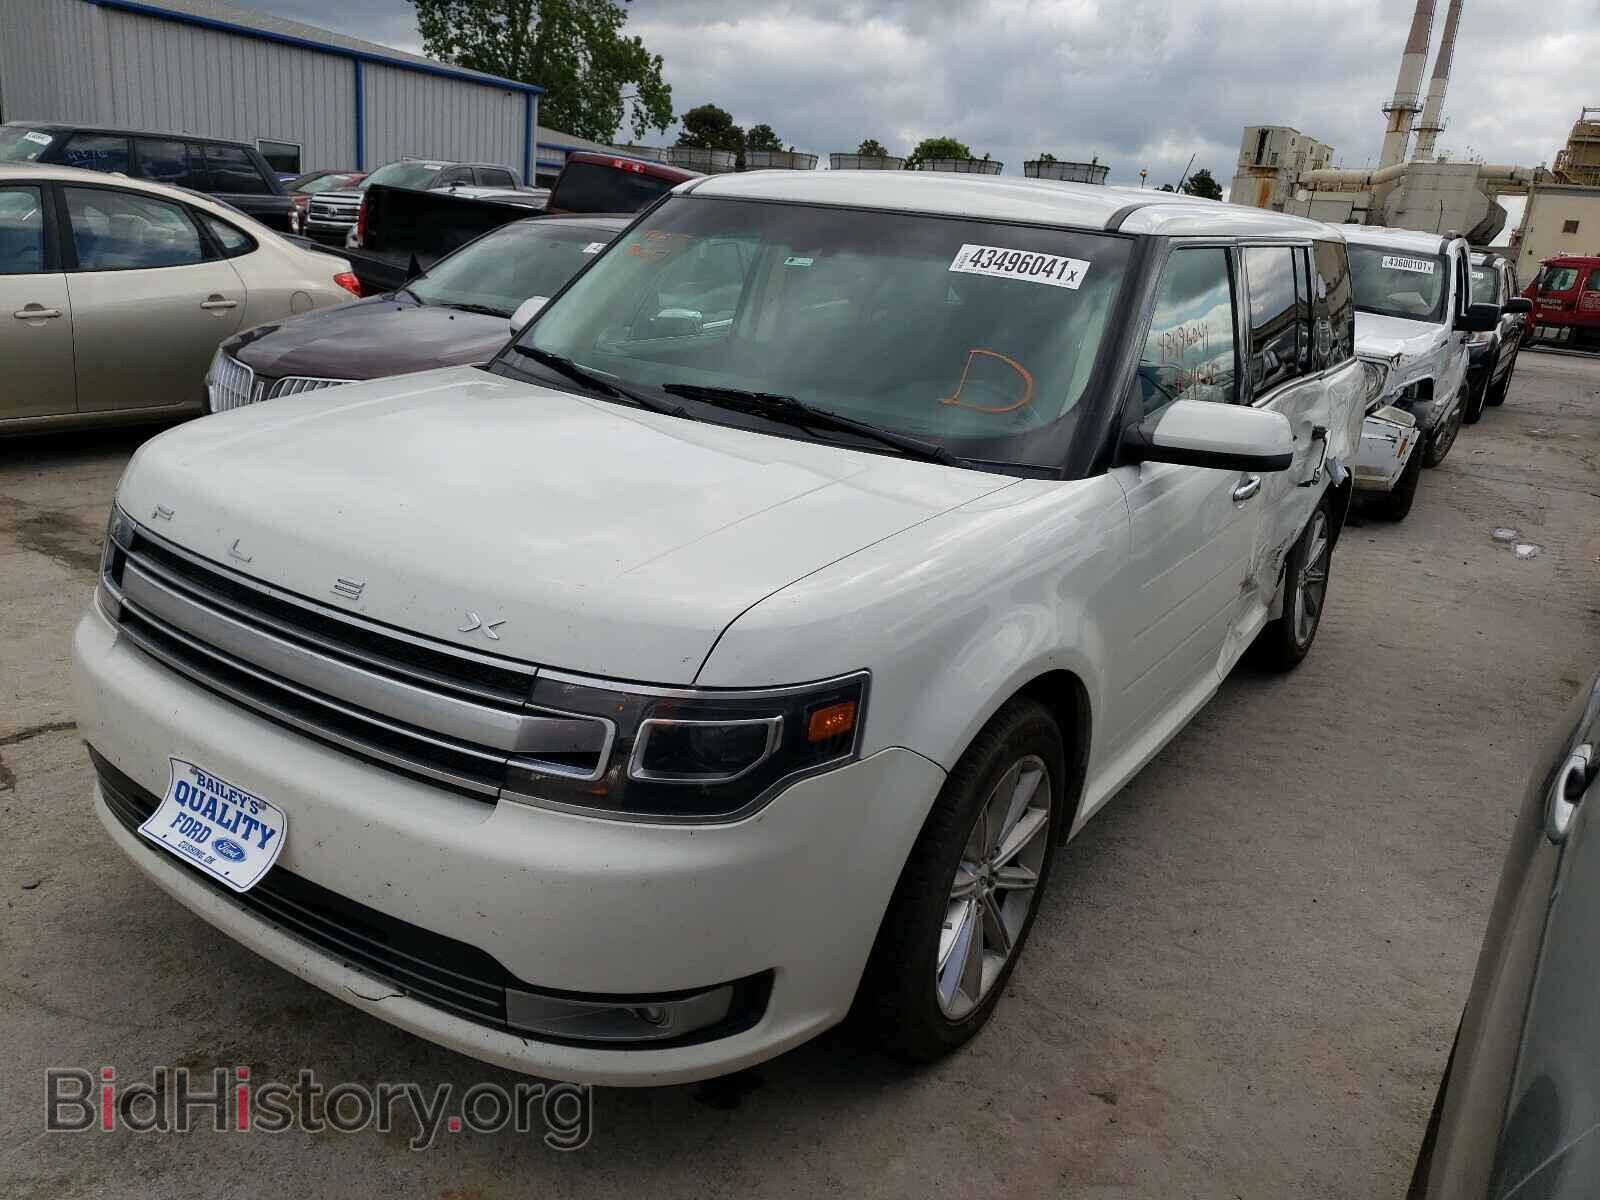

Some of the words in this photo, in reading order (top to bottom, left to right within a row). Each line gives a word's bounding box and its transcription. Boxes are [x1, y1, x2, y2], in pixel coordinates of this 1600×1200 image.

[970, 248, 1069, 280] 43496041
[943, 348, 1033, 413] D
[174, 780, 277, 850] QUALITY
[196, 772, 259, 815] BAILEY'S
[170, 811, 212, 844] FORD
